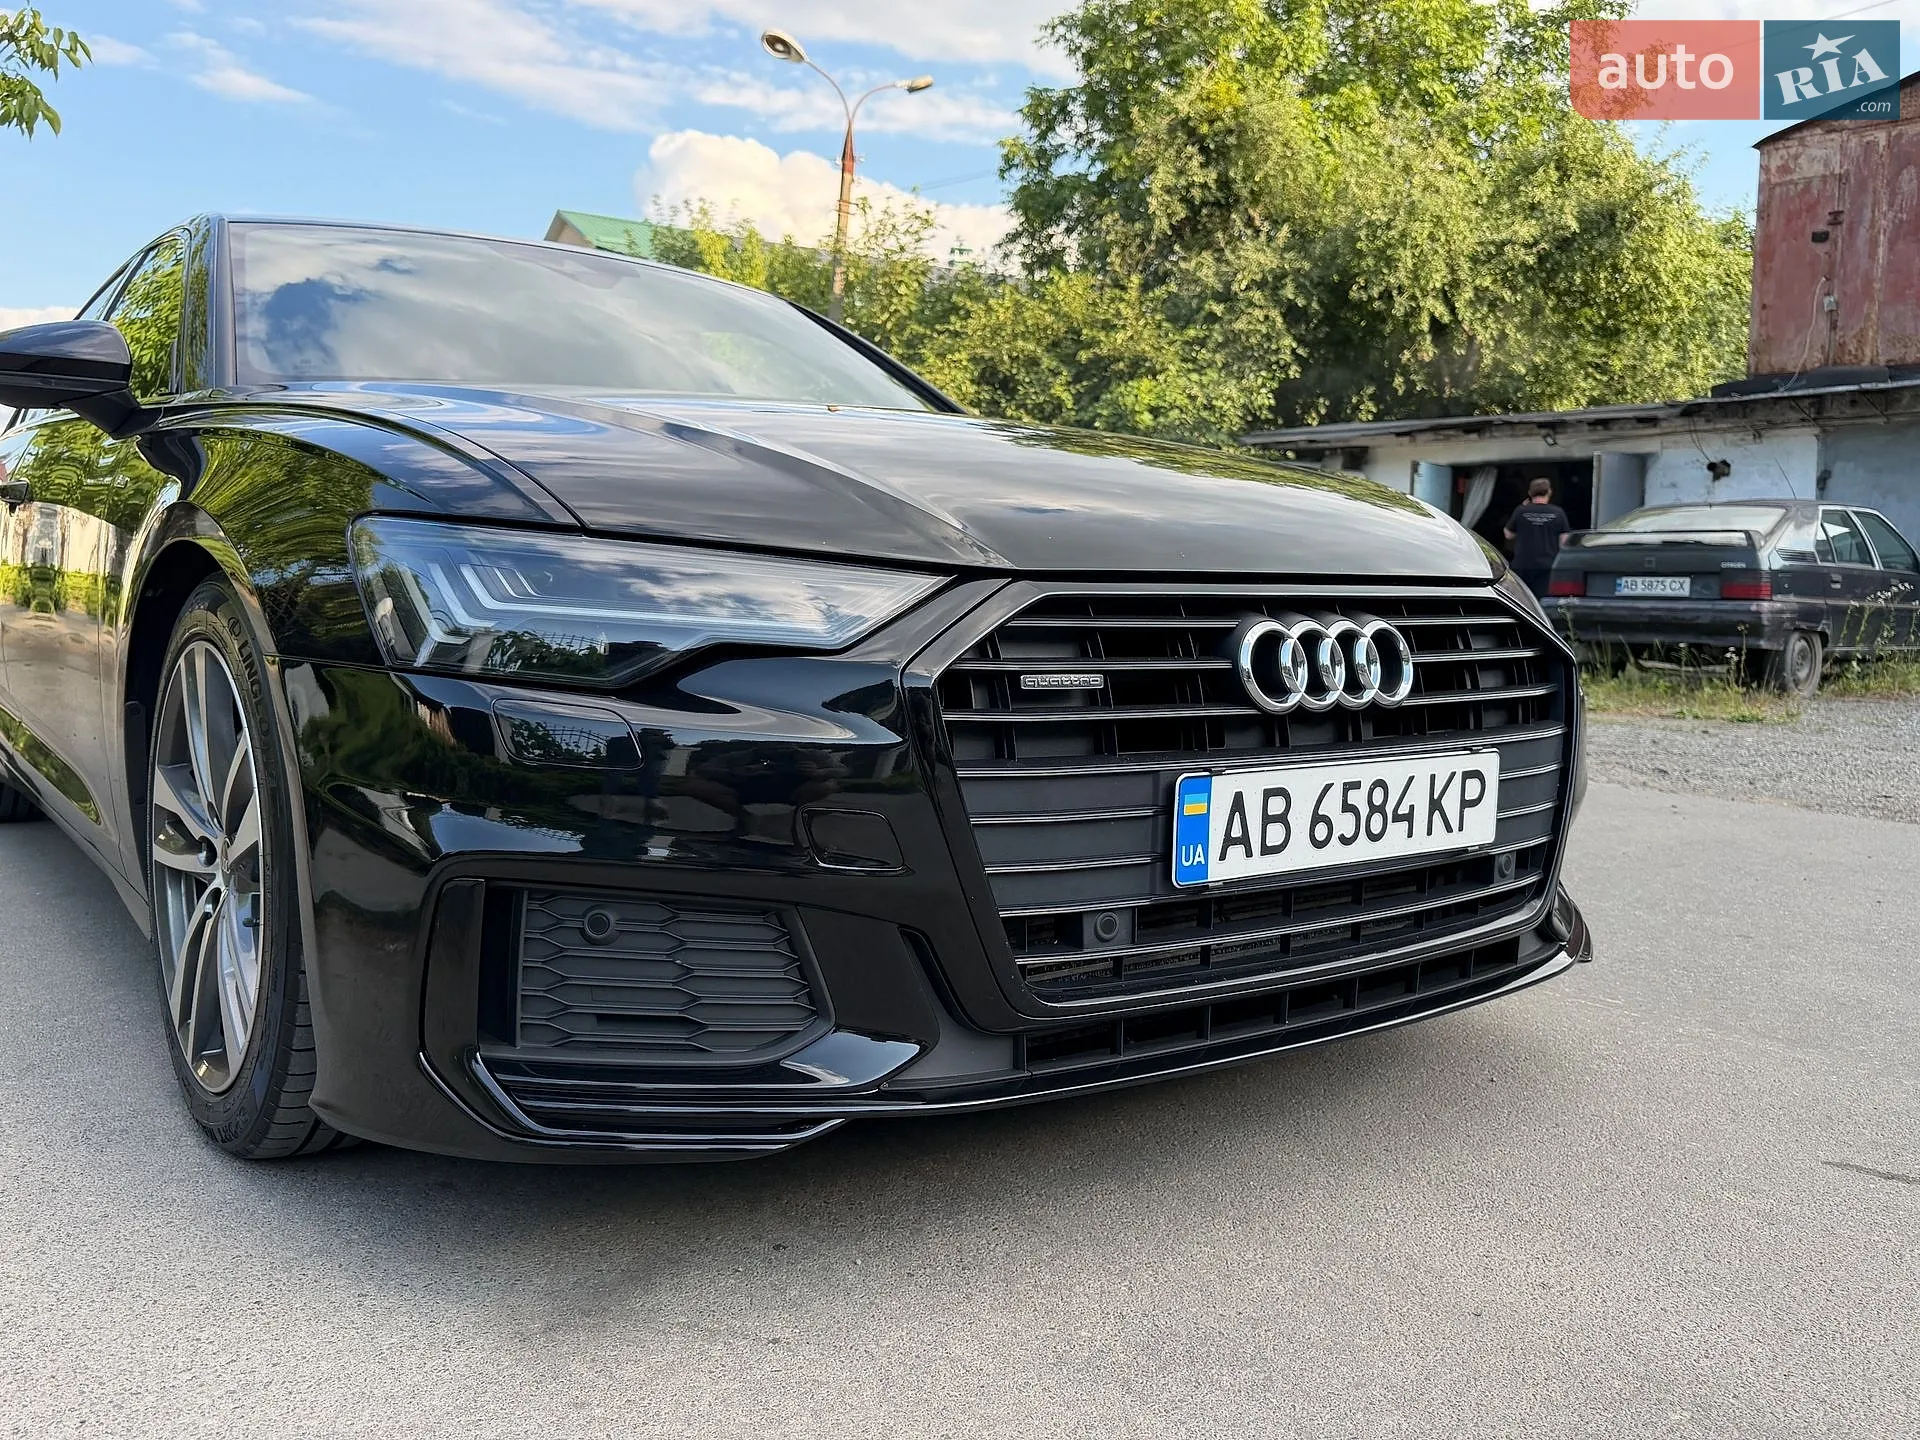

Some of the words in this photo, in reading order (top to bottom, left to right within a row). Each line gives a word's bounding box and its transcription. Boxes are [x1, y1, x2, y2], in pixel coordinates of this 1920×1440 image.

[1623, 579, 1638, 592] AB
[1641, 579, 1666, 592] 5875
[1669, 579, 1686, 592] CX
[1025, 677, 1101, 687] quattro
[1218, 785, 1292, 862] AB
[1309, 774, 1415, 850] 6584
[1426, 769, 1487, 837] KP
[1181, 843, 1206, 867] UA
